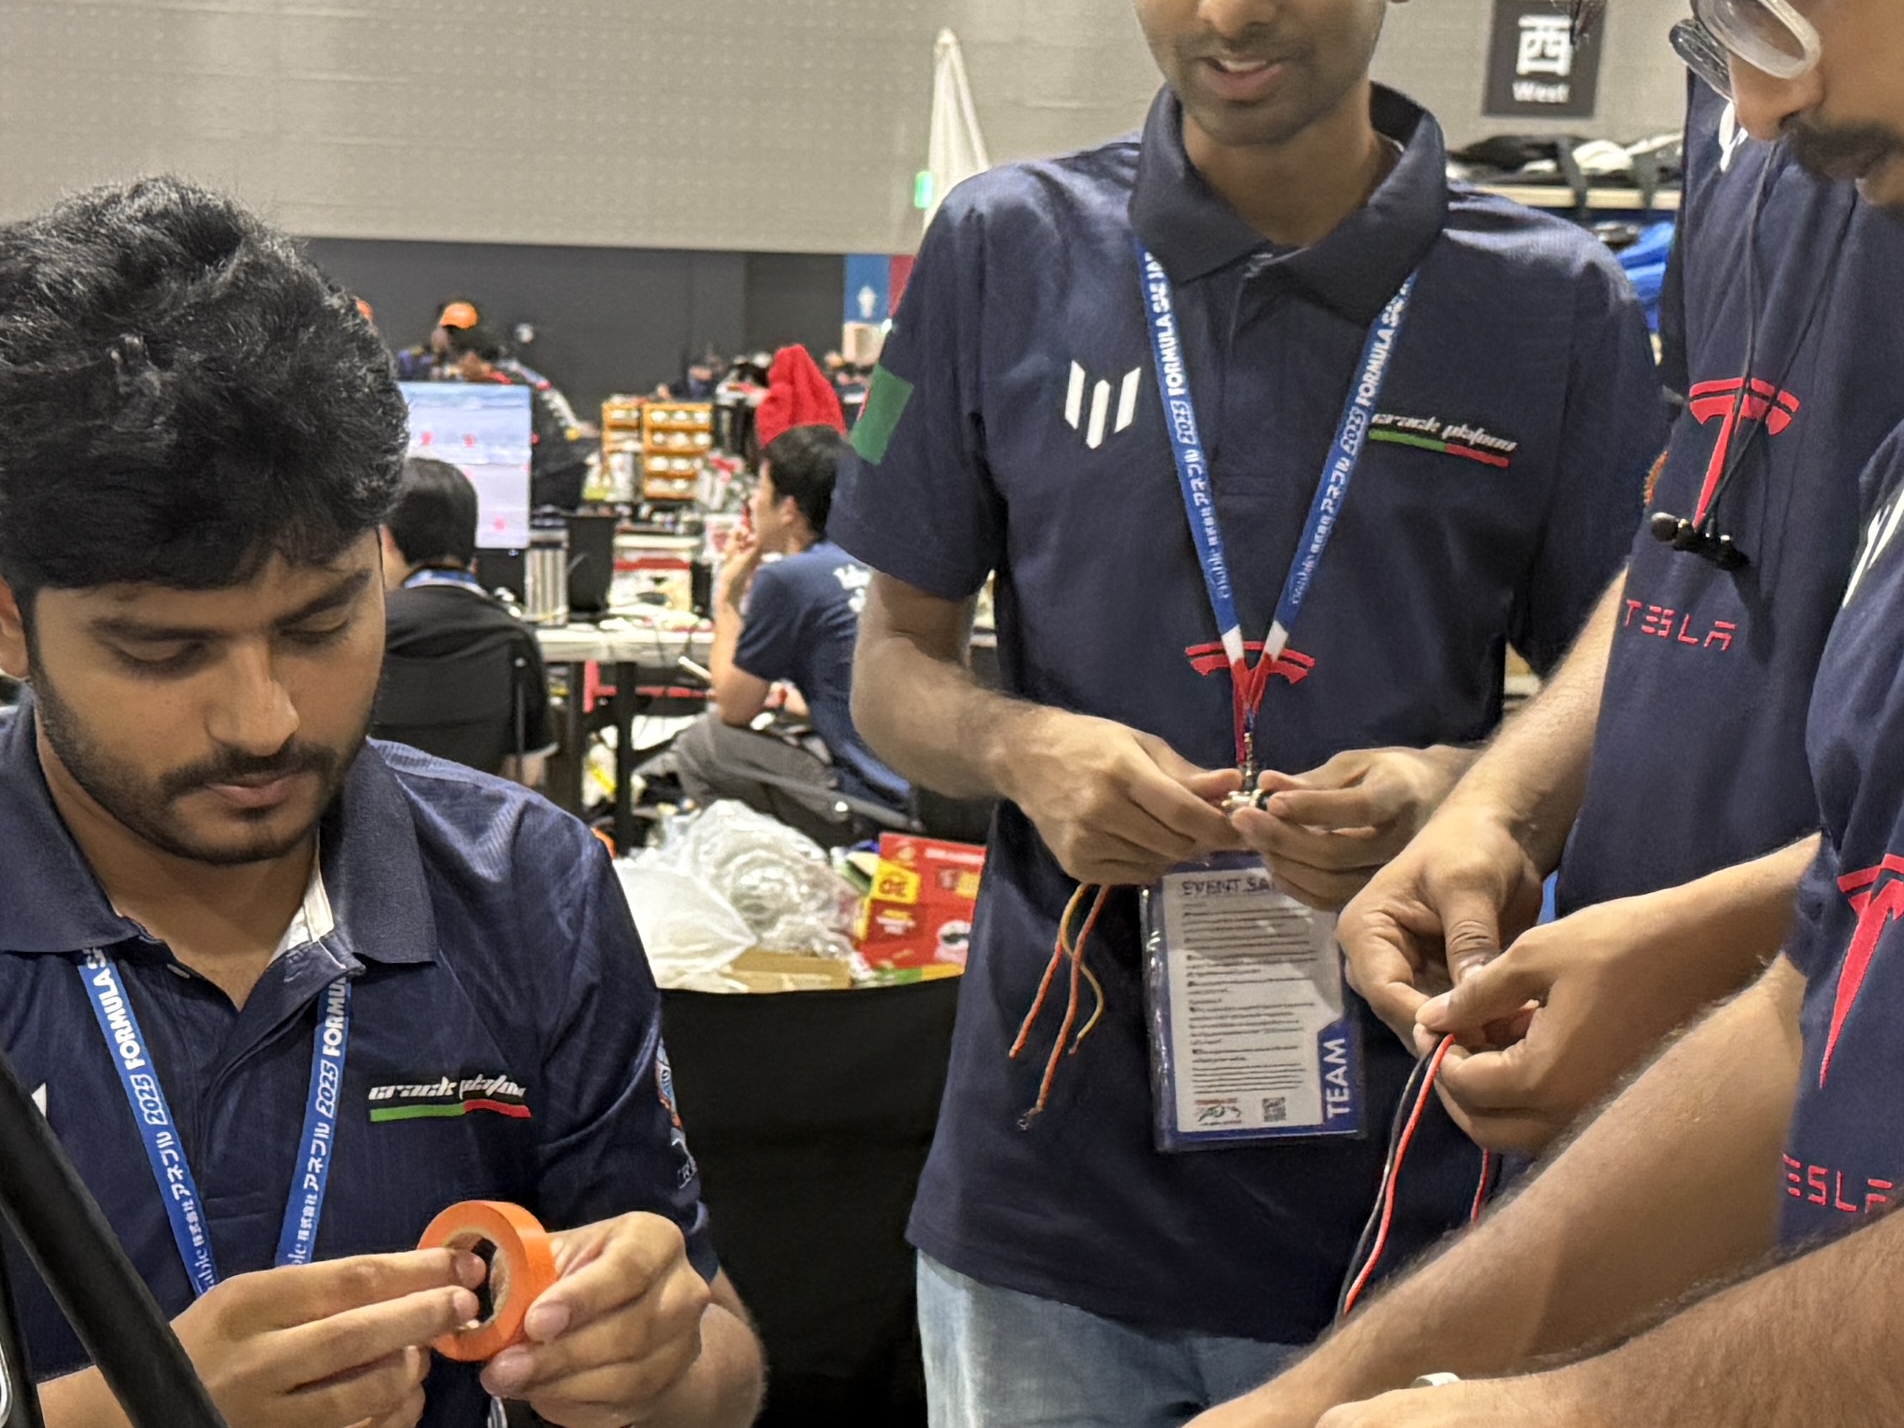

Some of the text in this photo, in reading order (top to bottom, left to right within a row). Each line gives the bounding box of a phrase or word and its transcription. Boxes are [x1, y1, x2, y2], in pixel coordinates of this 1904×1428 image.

[1517, 14, 1573, 76] 西
[1512, 81, 1570, 104] West
[1156, 314, 1186, 398] FORMULA
[1169, 399, 1198, 446] 2025
[1340, 407, 1367, 457] 2025
[1355, 329, 1395, 408] FORMULA
[1625, 599, 1737, 650] TESLA
[92, 969, 147, 1072] FORMULA
[130, 1074, 169, 1126] 2025
[315, 1058, 339, 1119] 2025
[368, 1076, 458, 1101] crack
[1324, 1038, 1350, 1120] TEAM
[1782, 1153, 1893, 1214] ESLA
